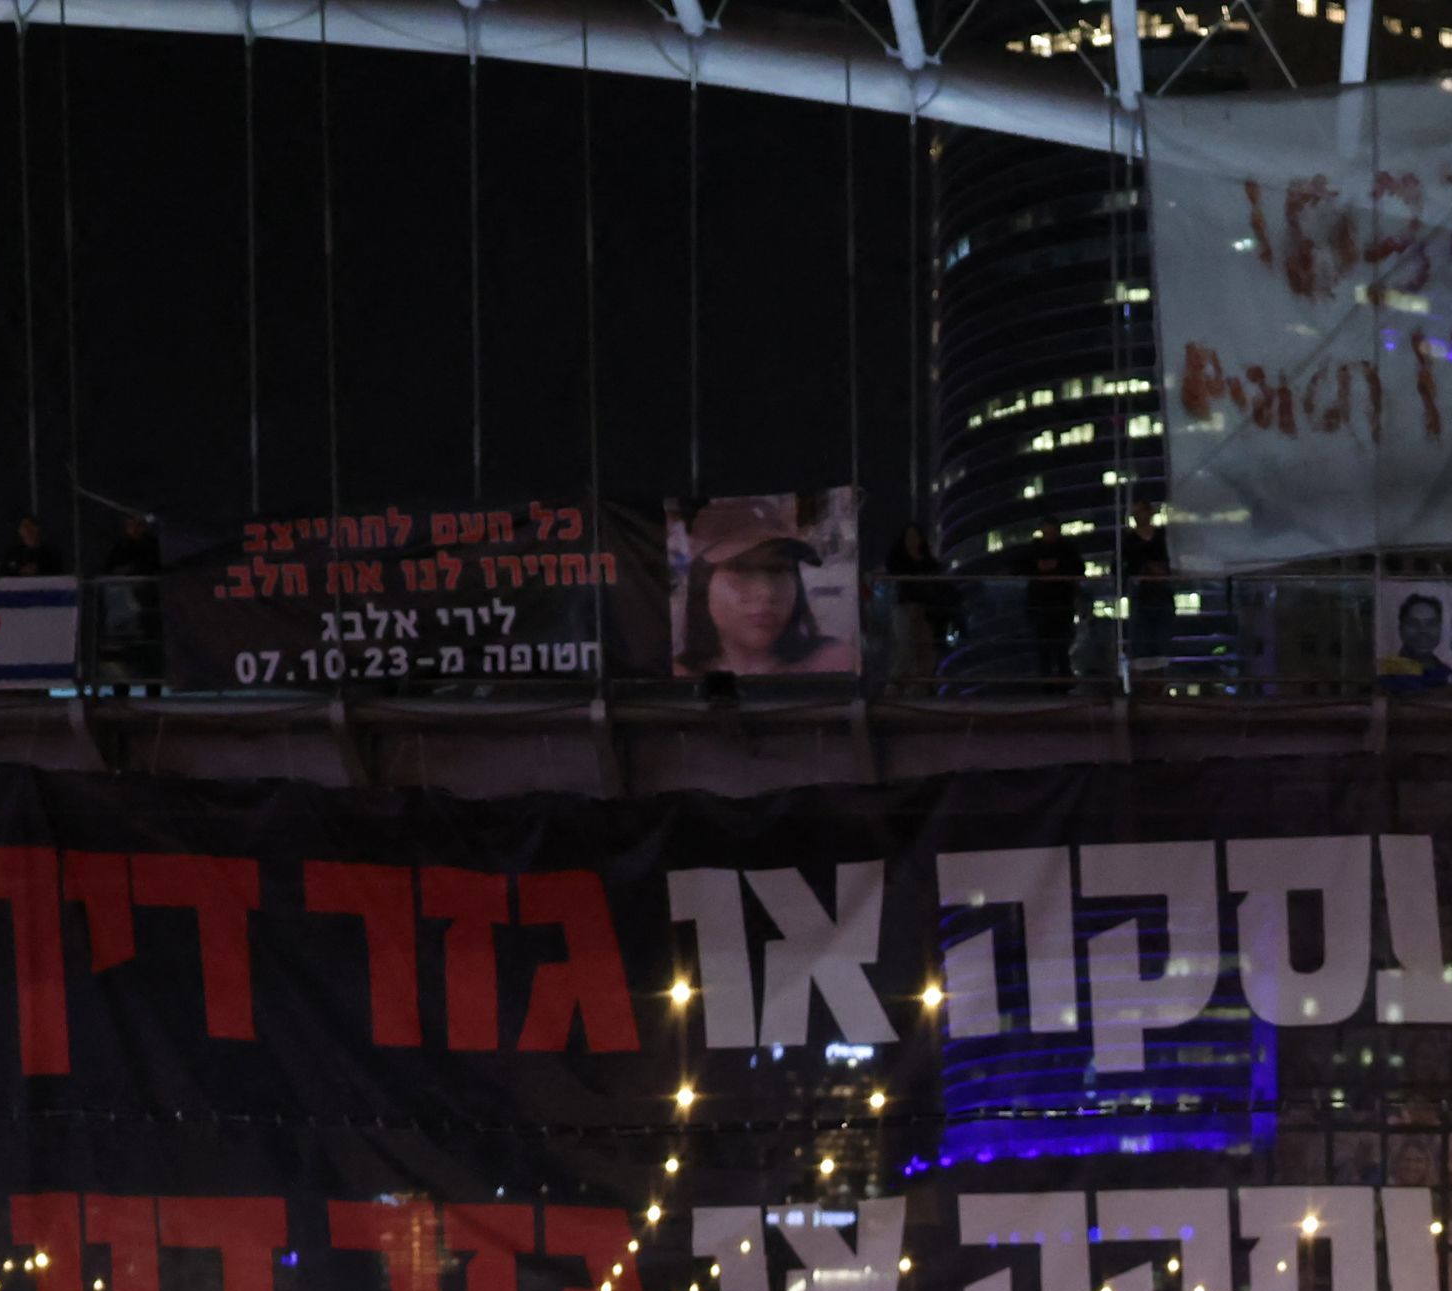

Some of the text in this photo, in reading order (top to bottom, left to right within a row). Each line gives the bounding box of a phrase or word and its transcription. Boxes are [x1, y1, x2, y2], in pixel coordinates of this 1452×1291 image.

[430, 510, 514, 546] העם
[529, 500, 583, 542] כל
[326, 558, 385, 594] את
[400, 550, 463, 592] לנו
[480, 552, 619, 590] תחזירו
[320, 596, 517, 643] לירי אלבג
[482, 640, 601, 674] חטופה
[301, 859, 641, 1053] גזר
[666, 858, 900, 1050] או
